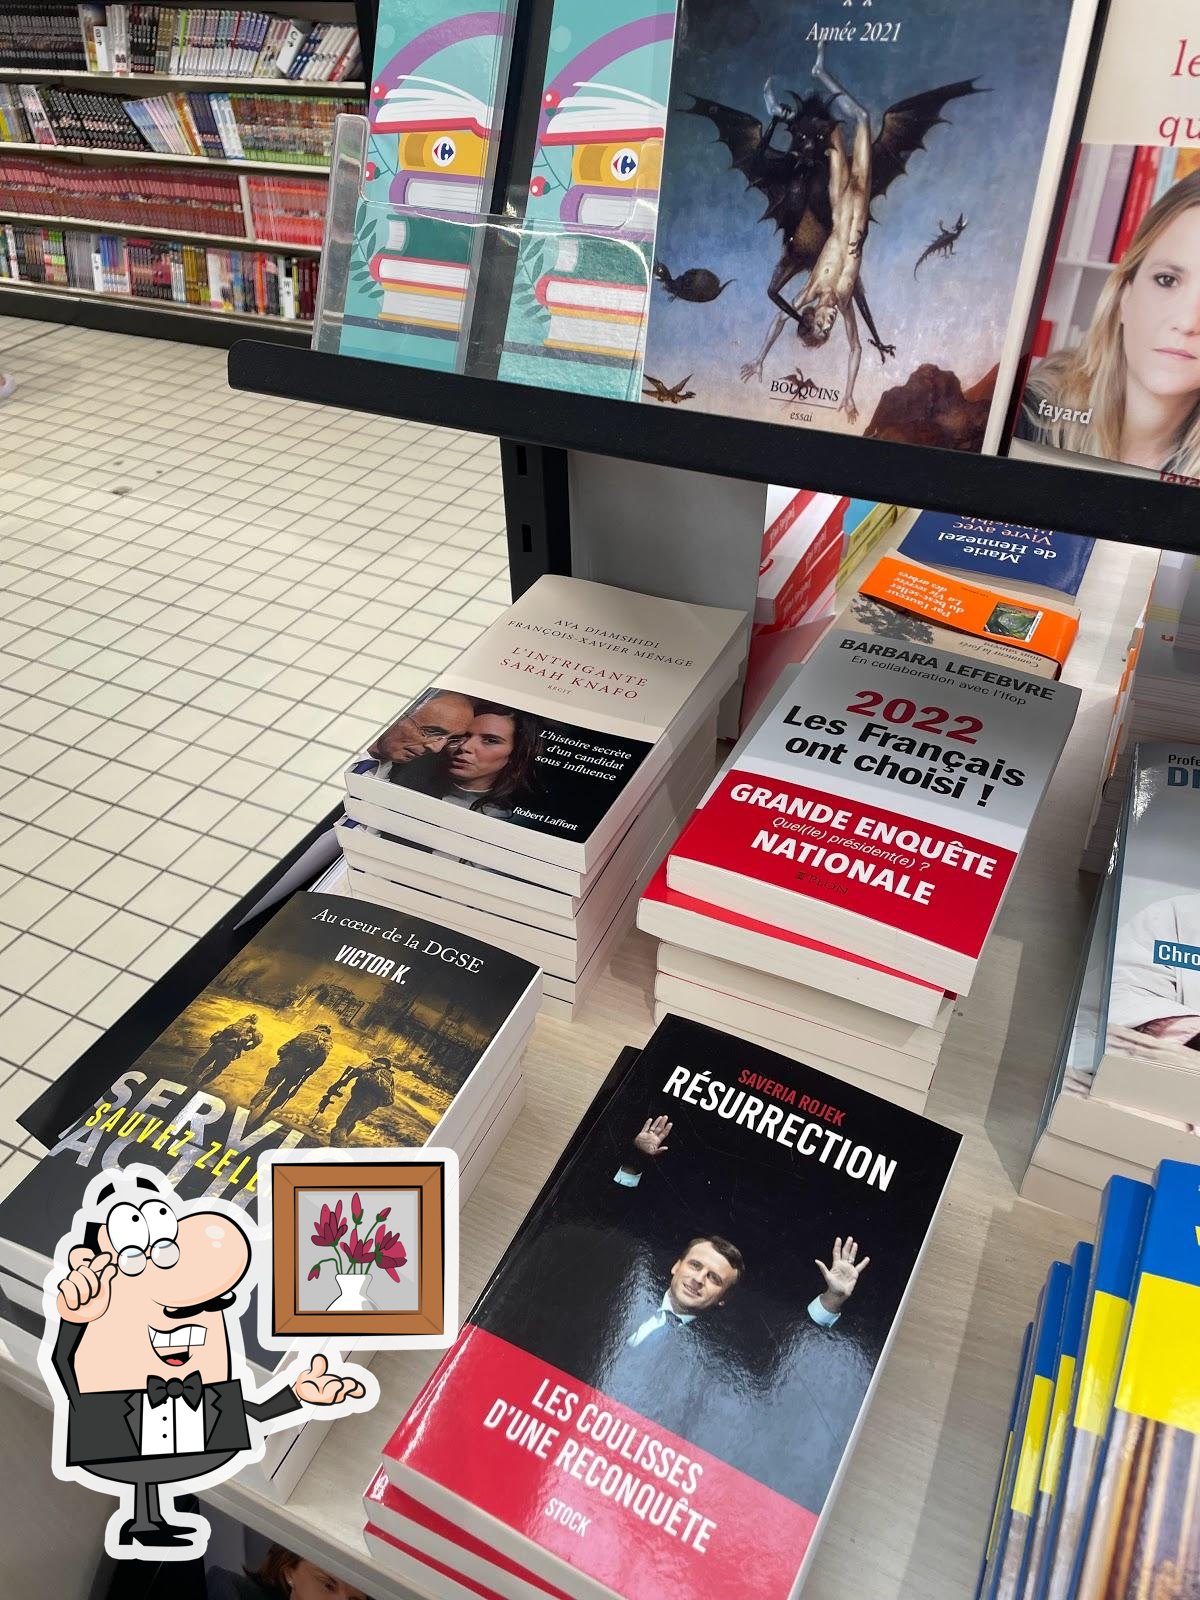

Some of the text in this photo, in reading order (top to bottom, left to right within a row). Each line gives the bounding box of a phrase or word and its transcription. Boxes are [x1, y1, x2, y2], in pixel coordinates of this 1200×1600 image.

[806, 20, 902, 42] Année 2021
[770, 380, 840, 402] BOUQUINS
[790, 411, 814, 423] essai
[1037, 399, 1093, 426] fayard
[938, 532, 1058, 560] de Hennezel
[952, 521, 996, 534] avec
[1002, 529, 1053, 546] Vivre
[963, 545, 1023, 565] Marie
[507, 619, 630, 655] FRANÇOIS-XAVIER
[552, 618, 580, 631] AVA
[499, 658, 639, 701] SARAH KNAFO
[511, 646, 649, 688] L'INTRIGANTE
[838, 638, 1056, 701] BARBARA LEFEBVRE
[851, 655, 869, 667] En
[870, 657, 956, 686] collaboration
[958, 682, 990, 695] avec
[845, 689, 985, 745] 2022
[538, 729, 632, 760] L'histoire secrète
[546, 744, 625, 771] d'un candidat
[782, 704, 1028, 788] Les Français
[534, 754, 617, 782] sous influence
[784, 735, 996, 808] ont choisi !
[512, 805, 579, 832] Robert Laffont
[729, 782, 998, 880] GRANDE ENQUÊTE
[772, 816, 828, 842] Quel(le)
[827, 833, 916, 869] président(e)
[750, 830, 936, 906] NATIONALE
[311, 907, 485, 975] Au cœur de la DGSE
[334, 944, 412, 986] VICTOR K.
[736, 1068, 847, 1128] SAVERIA ROJEK
[84, 1102, 196, 1159] SAUVEZ
[661, 1065, 898, 1193] RÉSURRECTION
[531, 1377, 704, 1496] LES COULISSES
[482, 1397, 718, 1554] D'UNE RECONQUÊTE
[543, 1496, 592, 1538] STOCK
